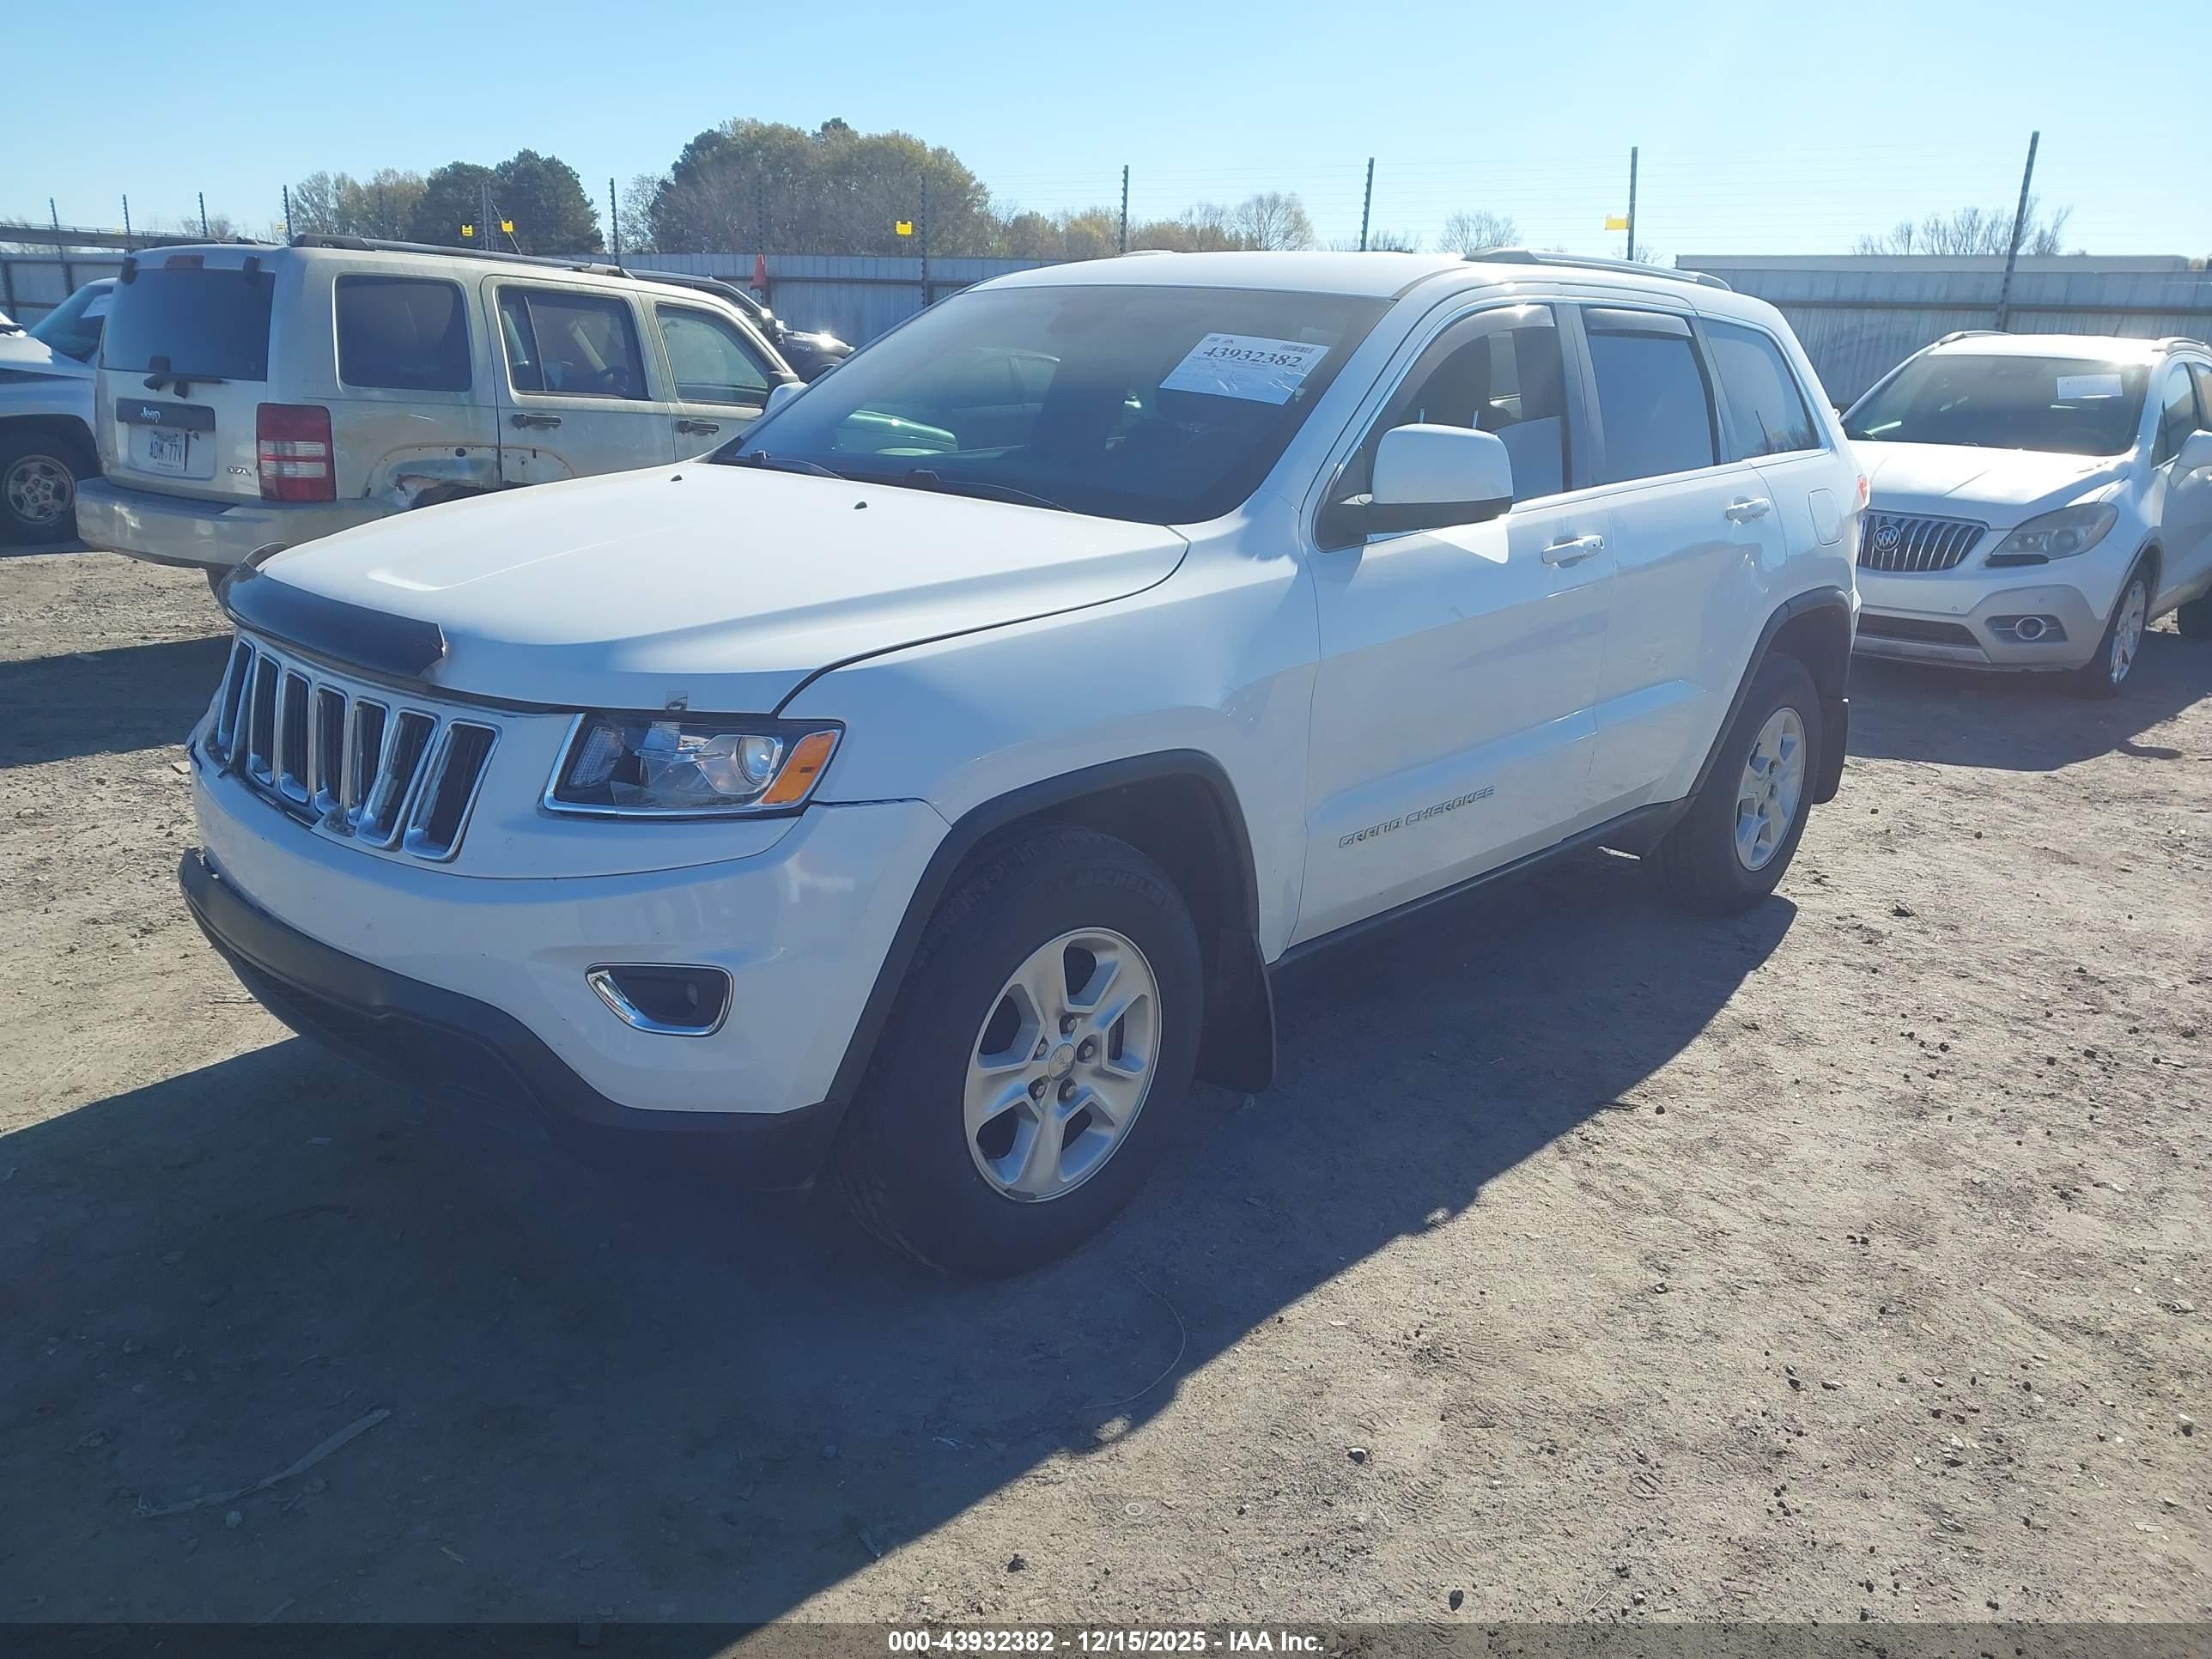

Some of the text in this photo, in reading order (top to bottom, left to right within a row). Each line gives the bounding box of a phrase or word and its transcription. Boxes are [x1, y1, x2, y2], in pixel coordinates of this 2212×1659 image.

[1202, 345, 1303, 368] 43932382
[141, 405, 161, 423] Jeep
[1339, 785, 1496, 848] GRAND CHEROKEE
[1073, 868, 1167, 907] MICHELIN
